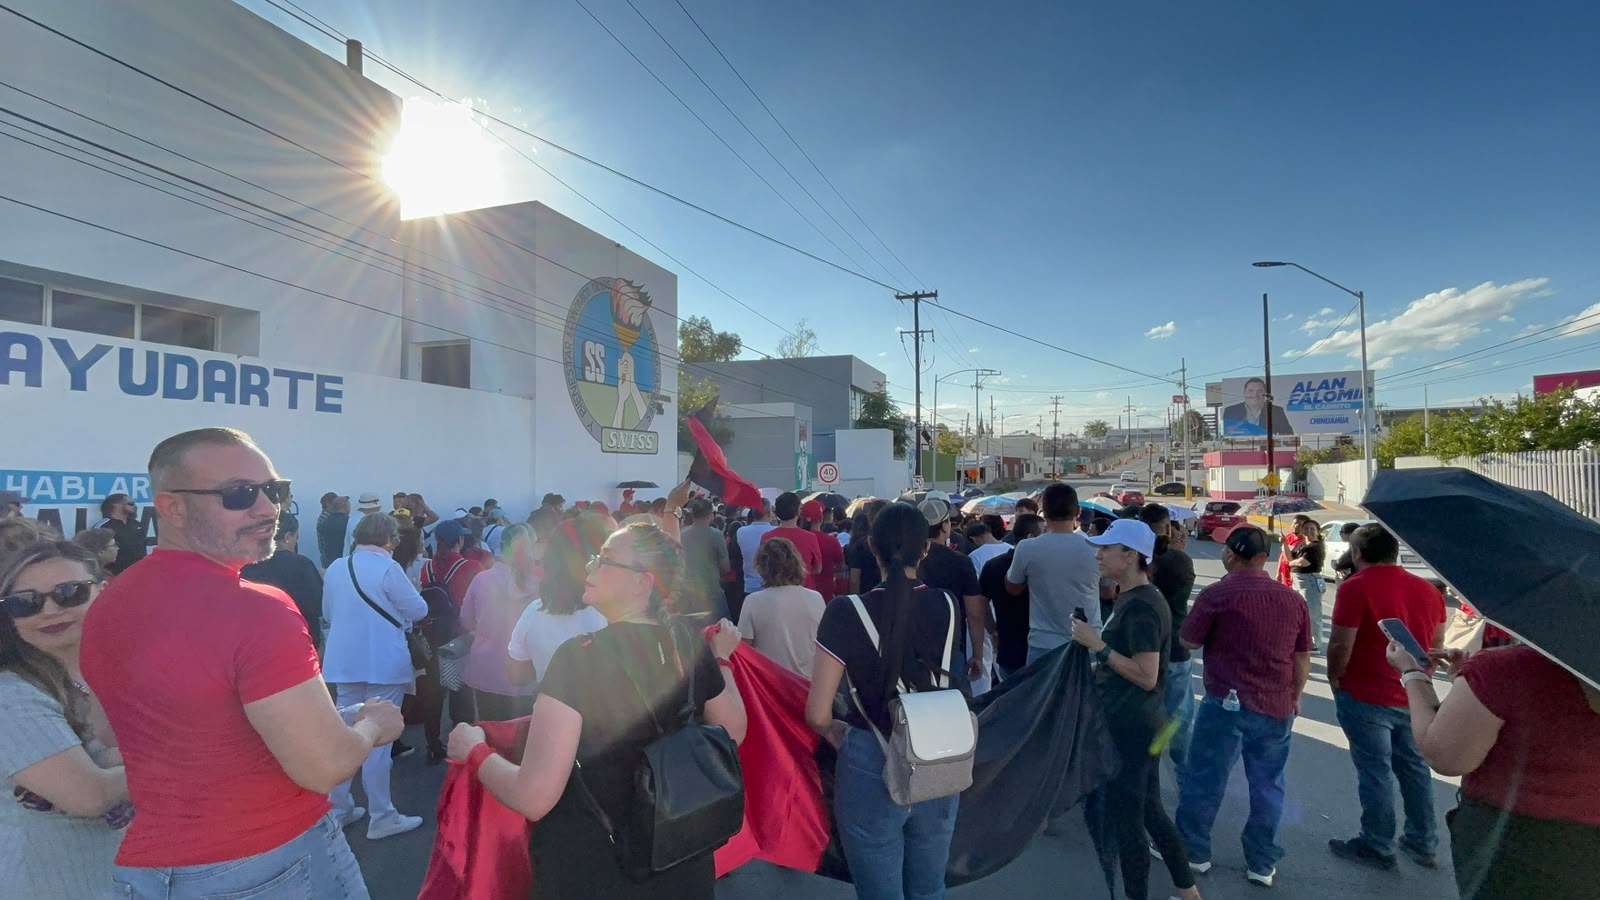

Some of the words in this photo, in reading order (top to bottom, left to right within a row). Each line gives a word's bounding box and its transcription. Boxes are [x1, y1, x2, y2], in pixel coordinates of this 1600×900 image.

[0, 331, 344, 414] AYUDARTE
[583, 340, 606, 384] SS
[1291, 377, 1346, 394] ALAN
[6, 474, 150, 501] HABLAR
